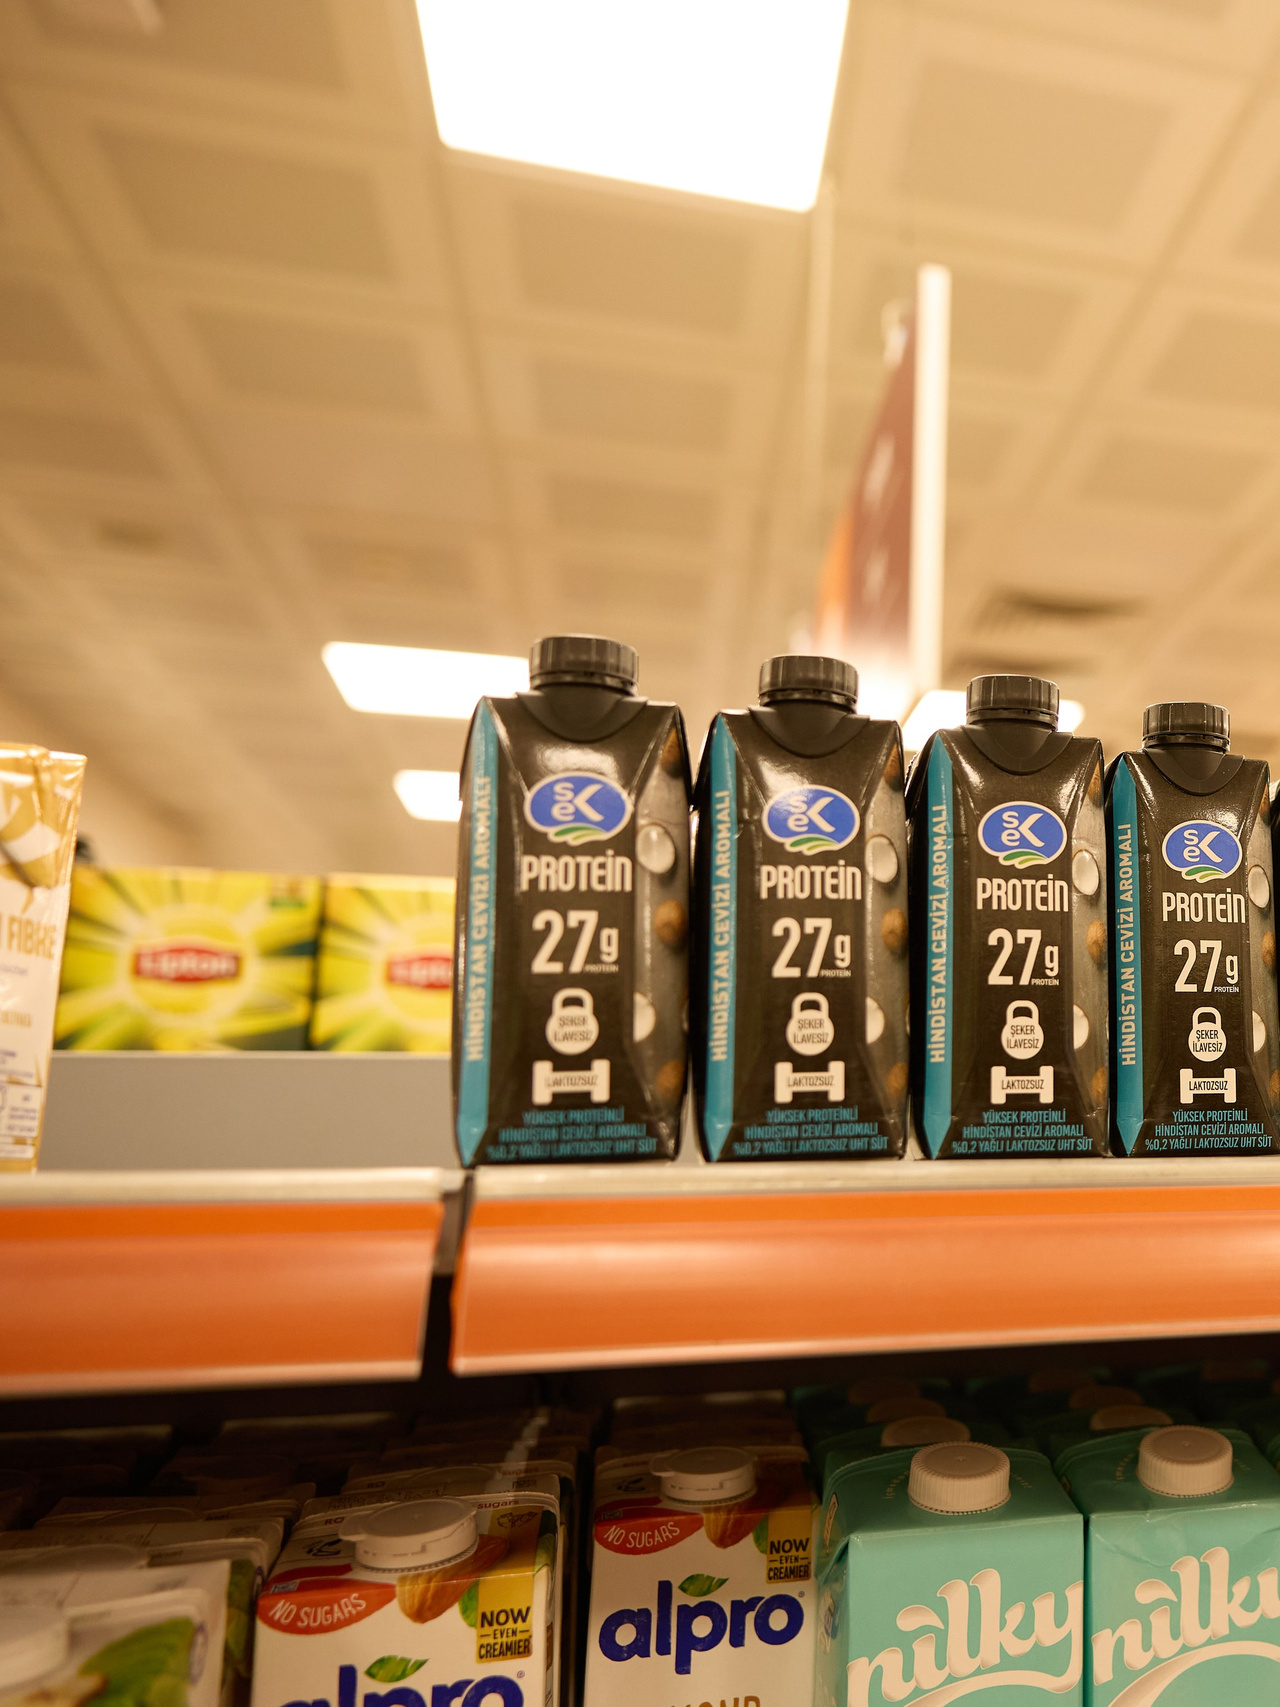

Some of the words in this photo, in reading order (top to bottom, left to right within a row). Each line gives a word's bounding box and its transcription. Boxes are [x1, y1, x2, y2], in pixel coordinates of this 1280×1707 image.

[931, 805, 948, 891] AROMALI
[1117, 824, 1134, 903] AROMALI
[1001, 1079, 1044, 1090] LAKTOZSUZ
[1189, 1081, 1228, 1091] LAKTOZSUZ
[603, 1525, 626, 1545] NO
[626, 1522, 681, 1549] SUGARS
[769, 1538, 809, 1555] NOW
[779, 1555, 799, 1564] EVEN
[768, 1564, 810, 1581] CREAMIER
[270, 1602, 296, 1626] NO
[297, 1593, 367, 1628] SUGARS
[480, 1606, 531, 1628] NOW
[493, 1628, 518, 1640] EVEN
[599, 1580, 804, 1675] alpro
[846, 1568, 1084, 1707] nilky
[478, 1639, 531, 1659] CREAMIER
